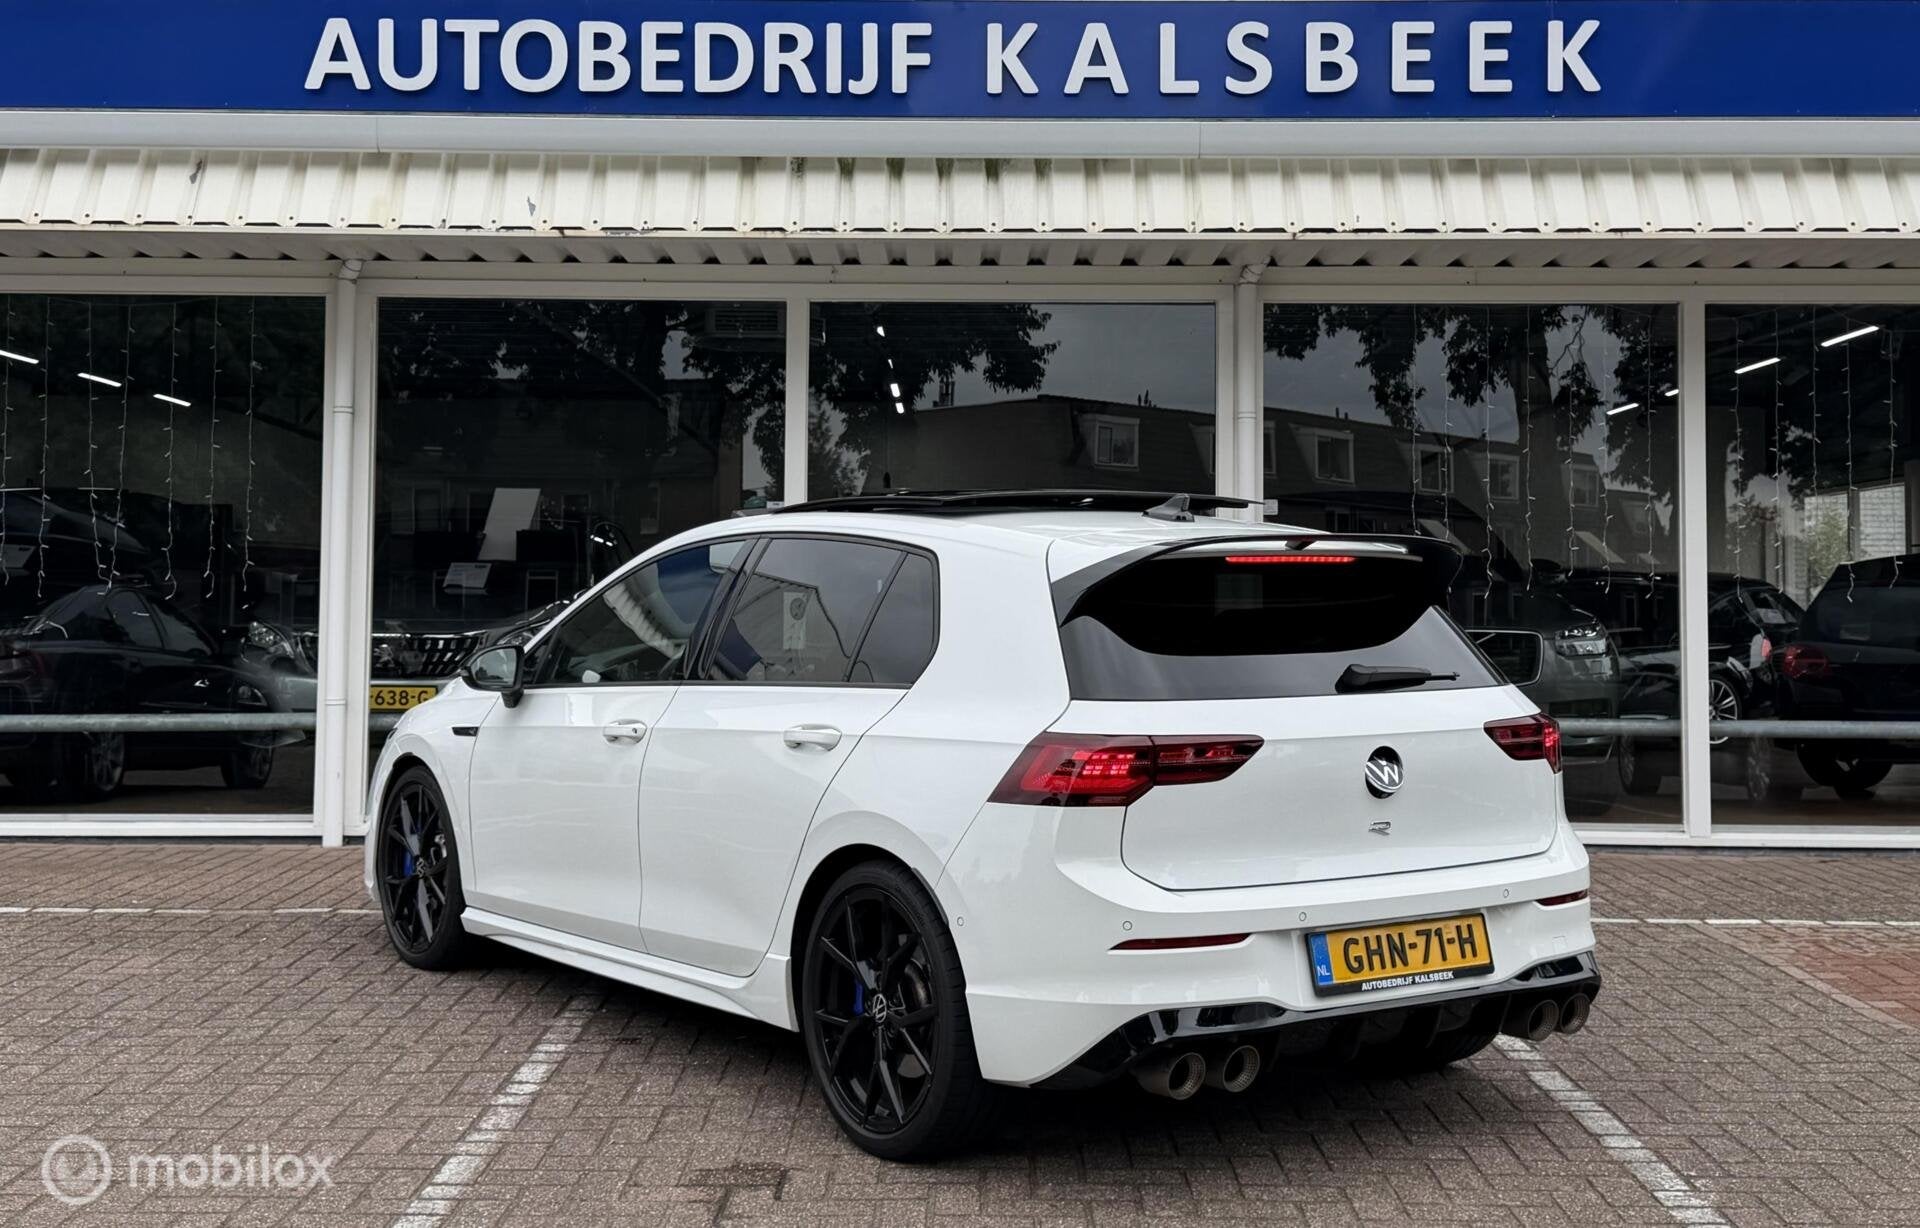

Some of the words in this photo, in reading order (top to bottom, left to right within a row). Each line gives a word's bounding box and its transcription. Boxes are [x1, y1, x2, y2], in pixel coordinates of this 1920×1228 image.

[304, 17, 931, 94] AUTOBEDRIJF
[986, 19, 1601, 94] KALSBEEK
[1343, 923, 1478, 974] GHN-71-H
[1317, 964, 1330, 977] NL
[1361, 976, 1413, 991] AUTOBEDRIJF
[1414, 971, 1454, 984] KALSBEEK
